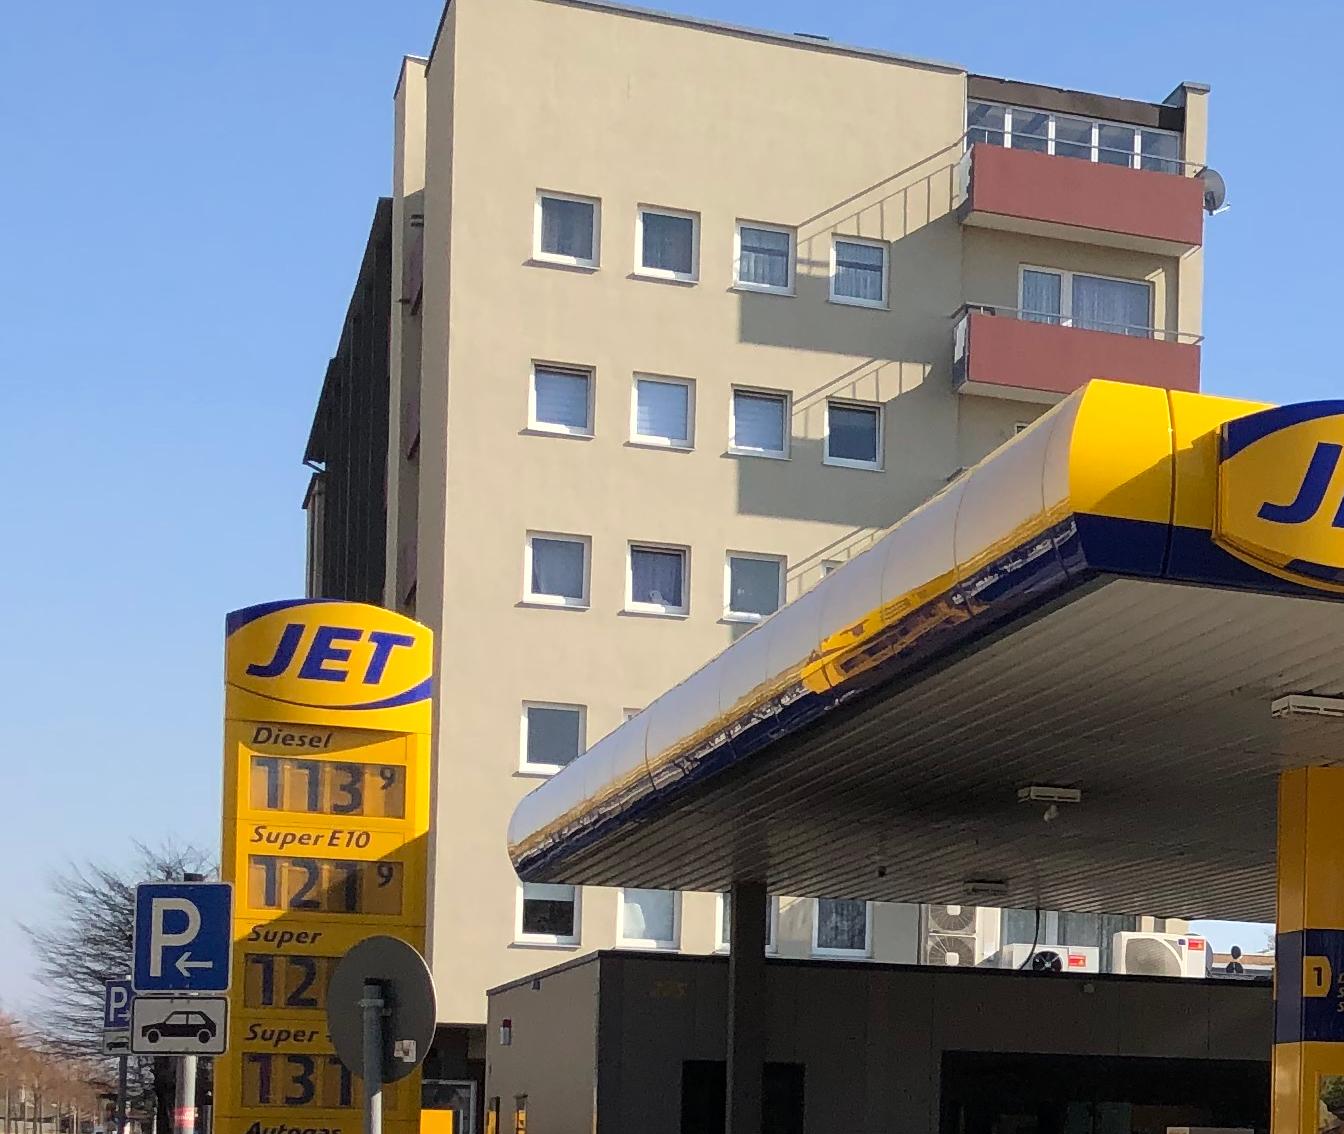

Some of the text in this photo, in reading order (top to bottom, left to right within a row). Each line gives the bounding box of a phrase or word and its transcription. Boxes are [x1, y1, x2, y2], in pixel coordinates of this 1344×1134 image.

[246, 624, 413, 684] JET
[252, 727, 334, 748] Diesel
[250, 826, 371, 849] Super E10
[150, 897, 201, 977] P
[247, 925, 322, 947] Super
[1313, 966, 1323, 986] 1
[110, 986, 128, 1022] P
[245, 1024, 319, 1044] Super
